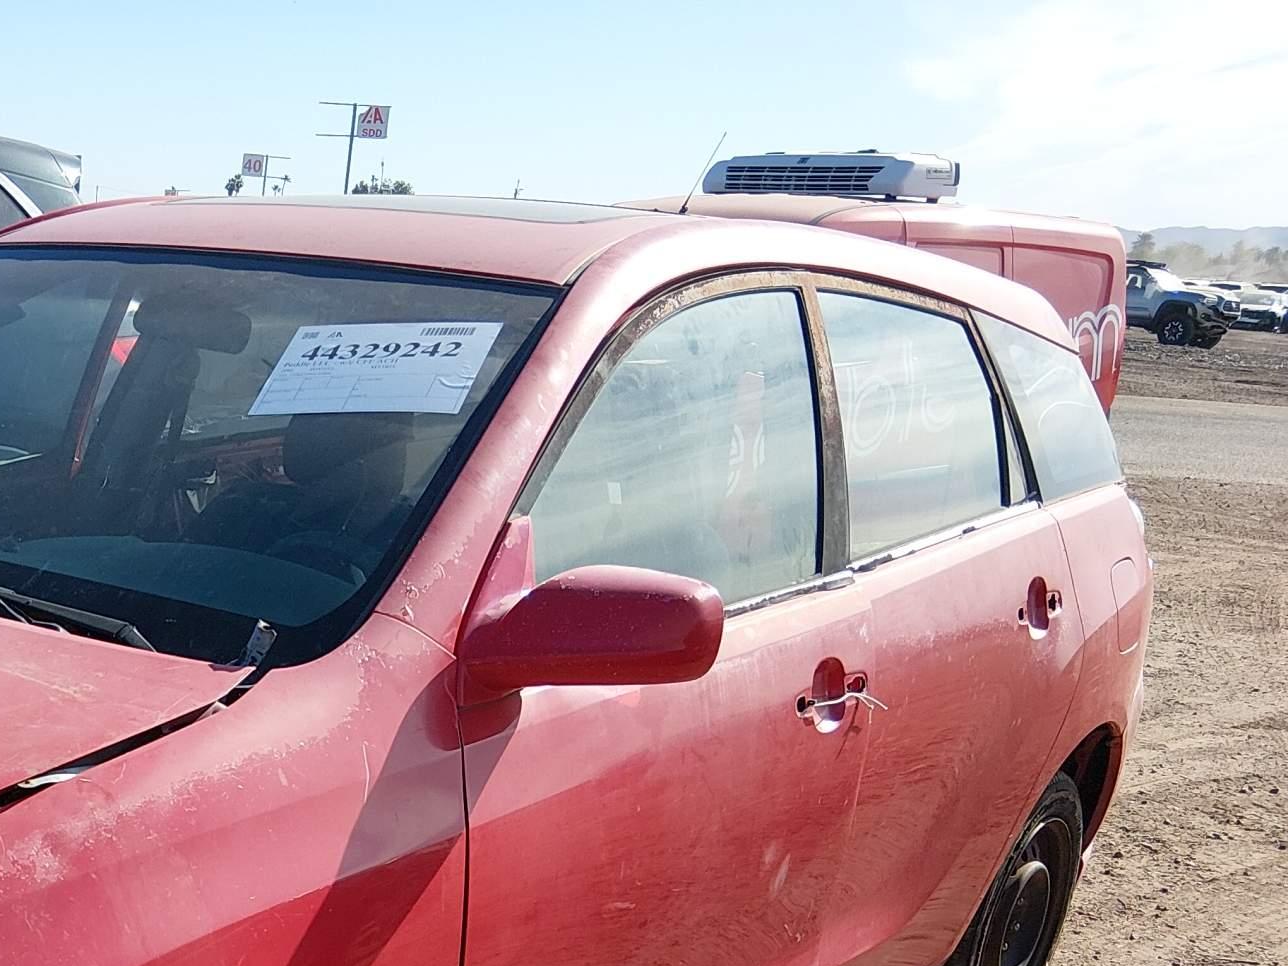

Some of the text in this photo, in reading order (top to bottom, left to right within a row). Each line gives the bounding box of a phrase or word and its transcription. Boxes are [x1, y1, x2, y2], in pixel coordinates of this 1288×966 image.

[361, 128, 383, 138] SDD
[242, 158, 262, 174] 40
[300, 341, 464, 361] 44329242
